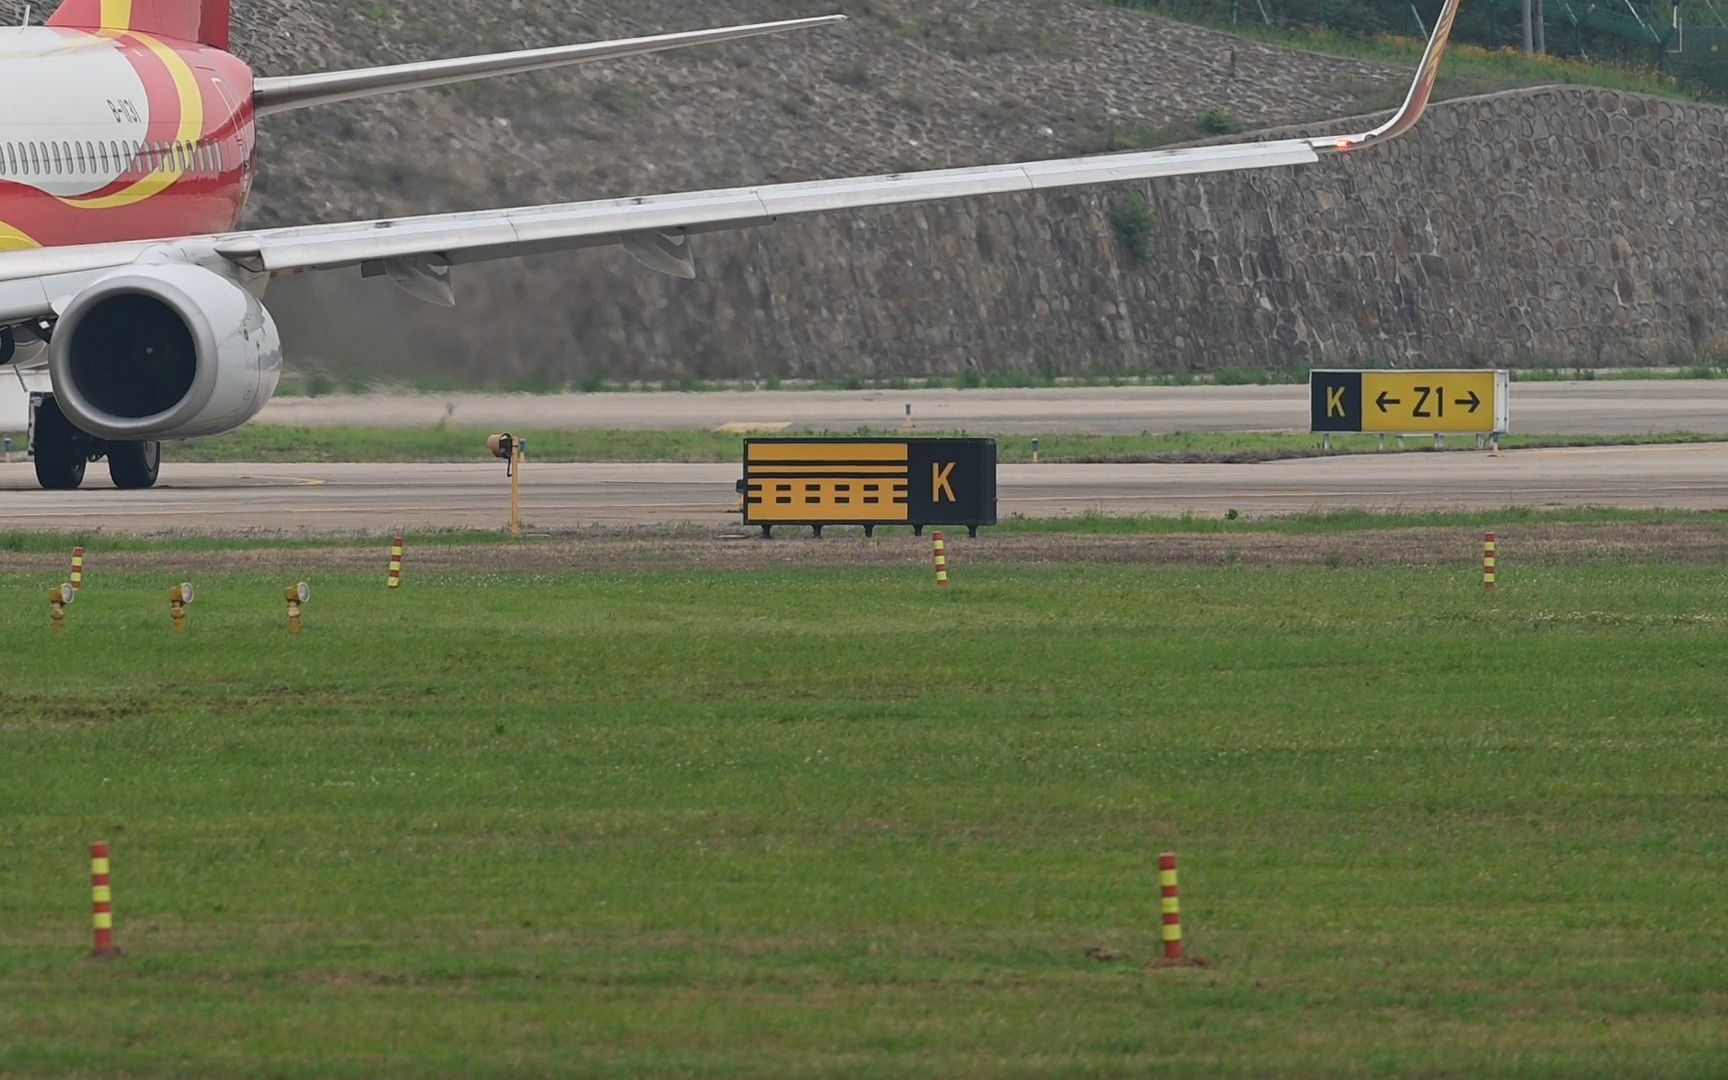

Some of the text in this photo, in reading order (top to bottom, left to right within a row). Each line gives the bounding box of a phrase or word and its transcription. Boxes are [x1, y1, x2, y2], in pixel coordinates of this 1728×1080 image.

[1326, 385, 1444, 418] K Z1
[932, 462, 956, 502] K
